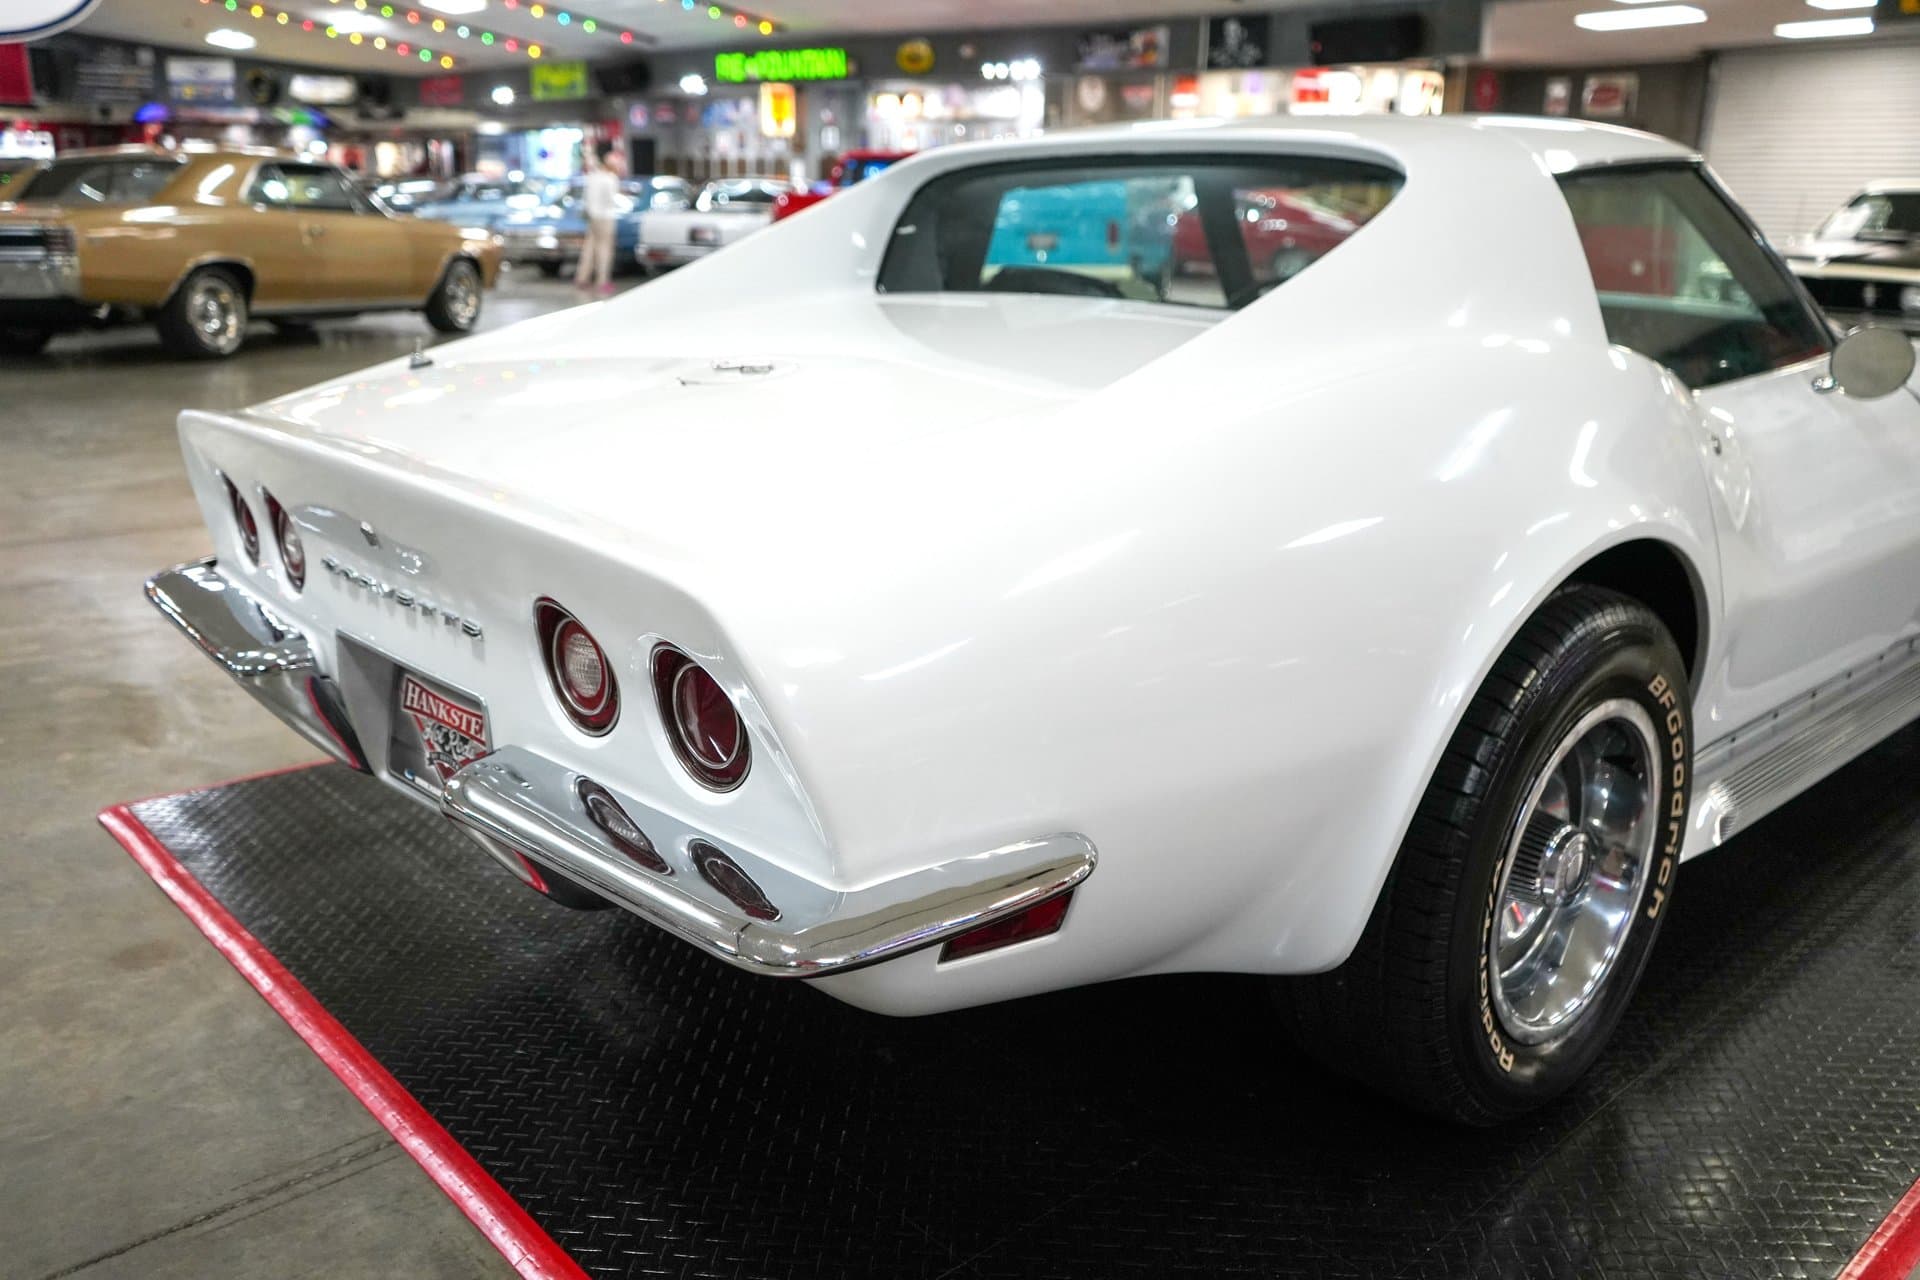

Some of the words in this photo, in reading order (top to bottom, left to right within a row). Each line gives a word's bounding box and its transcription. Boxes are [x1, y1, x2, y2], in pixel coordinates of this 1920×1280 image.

[405, 682, 487, 742] HANKSTE
[1647, 674, 1686, 919] BFGoodrich
[1478, 953, 1515, 1073] Radial
